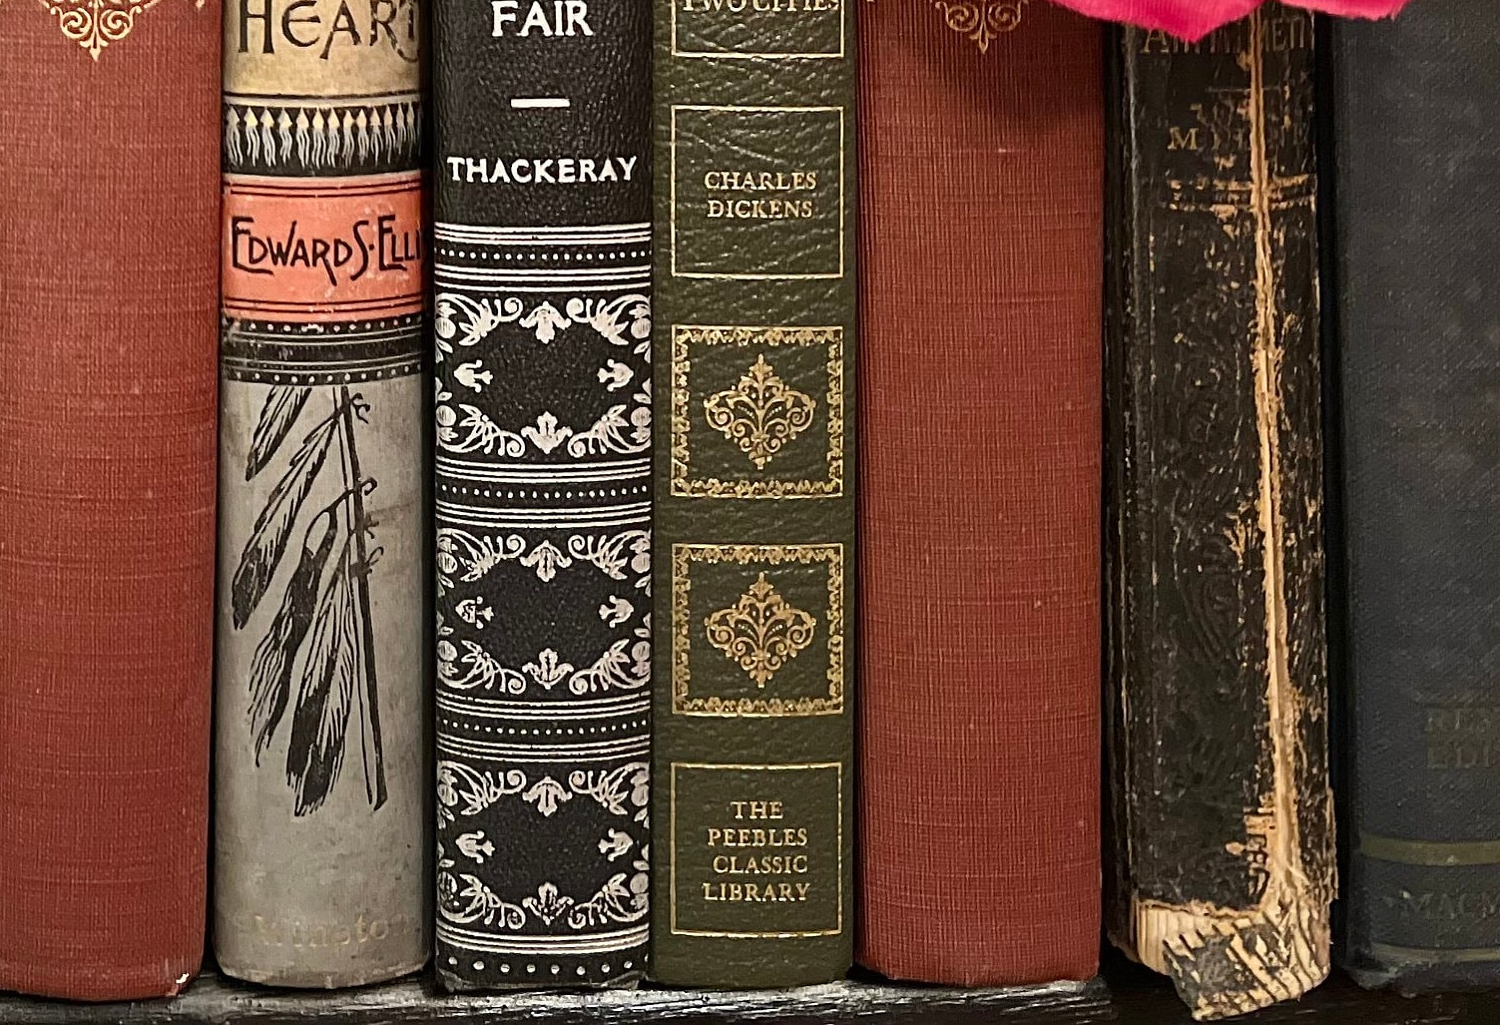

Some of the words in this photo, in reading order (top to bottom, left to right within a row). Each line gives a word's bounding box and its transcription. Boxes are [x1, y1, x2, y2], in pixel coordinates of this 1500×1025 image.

[491, 0, 594, 38] FAIR
[447, 156, 638, 184] THACKERAY
[704, 171, 817, 190] CHARLES
[707, 200, 813, 218] DICKENS
[730, 801, 784, 820] THE
[707, 828, 808, 847] PEEBLES
[712, 855, 808, 874] CLASSIC
[701, 882, 811, 902] LIBRARY
